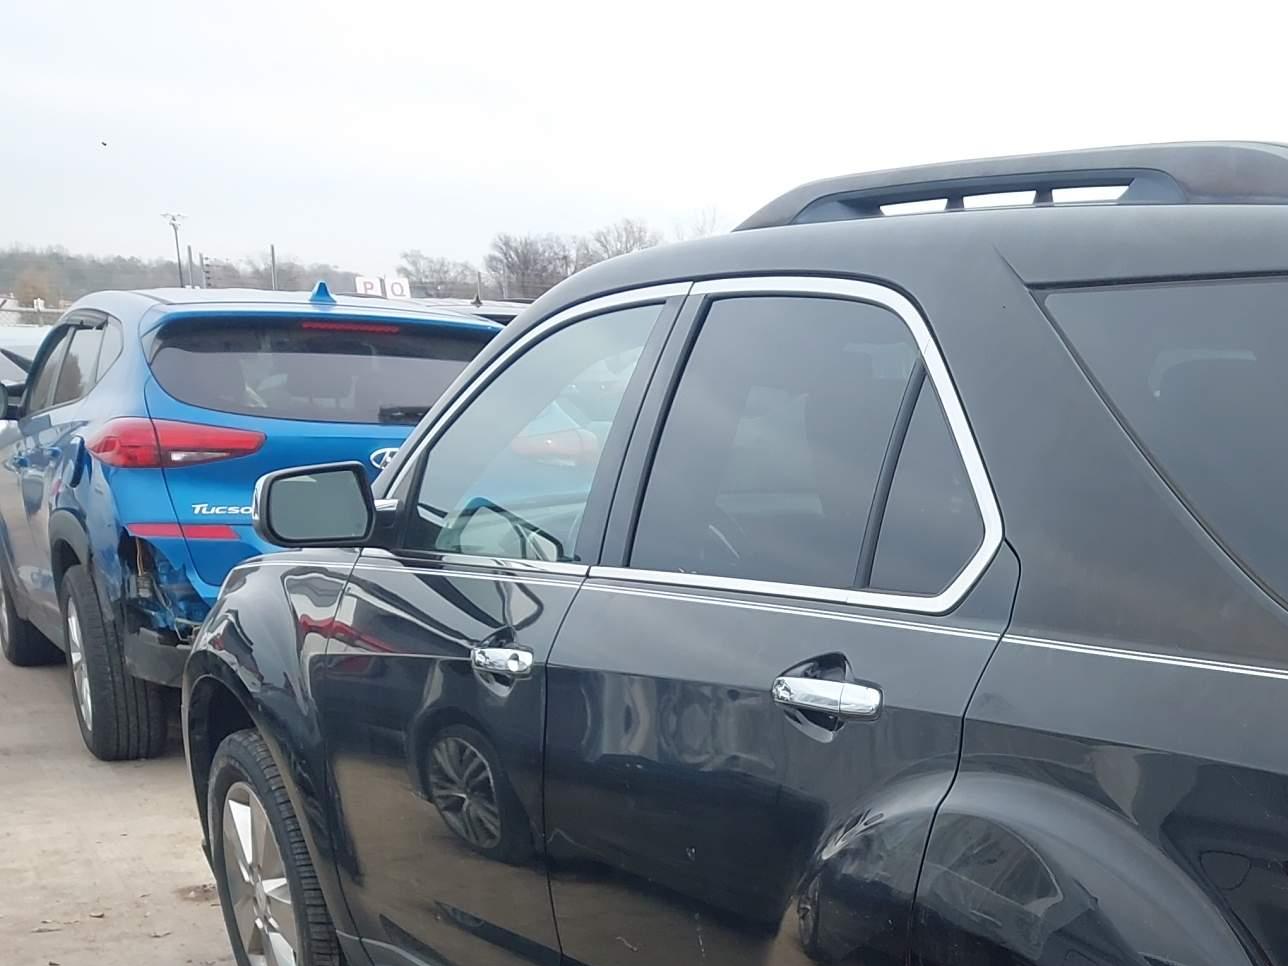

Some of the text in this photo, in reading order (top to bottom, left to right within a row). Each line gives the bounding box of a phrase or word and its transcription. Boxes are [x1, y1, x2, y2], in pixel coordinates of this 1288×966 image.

[363, 281, 374, 294] P
[390, 282, 406, 297] Q
[192, 504, 253, 515] Tucso
